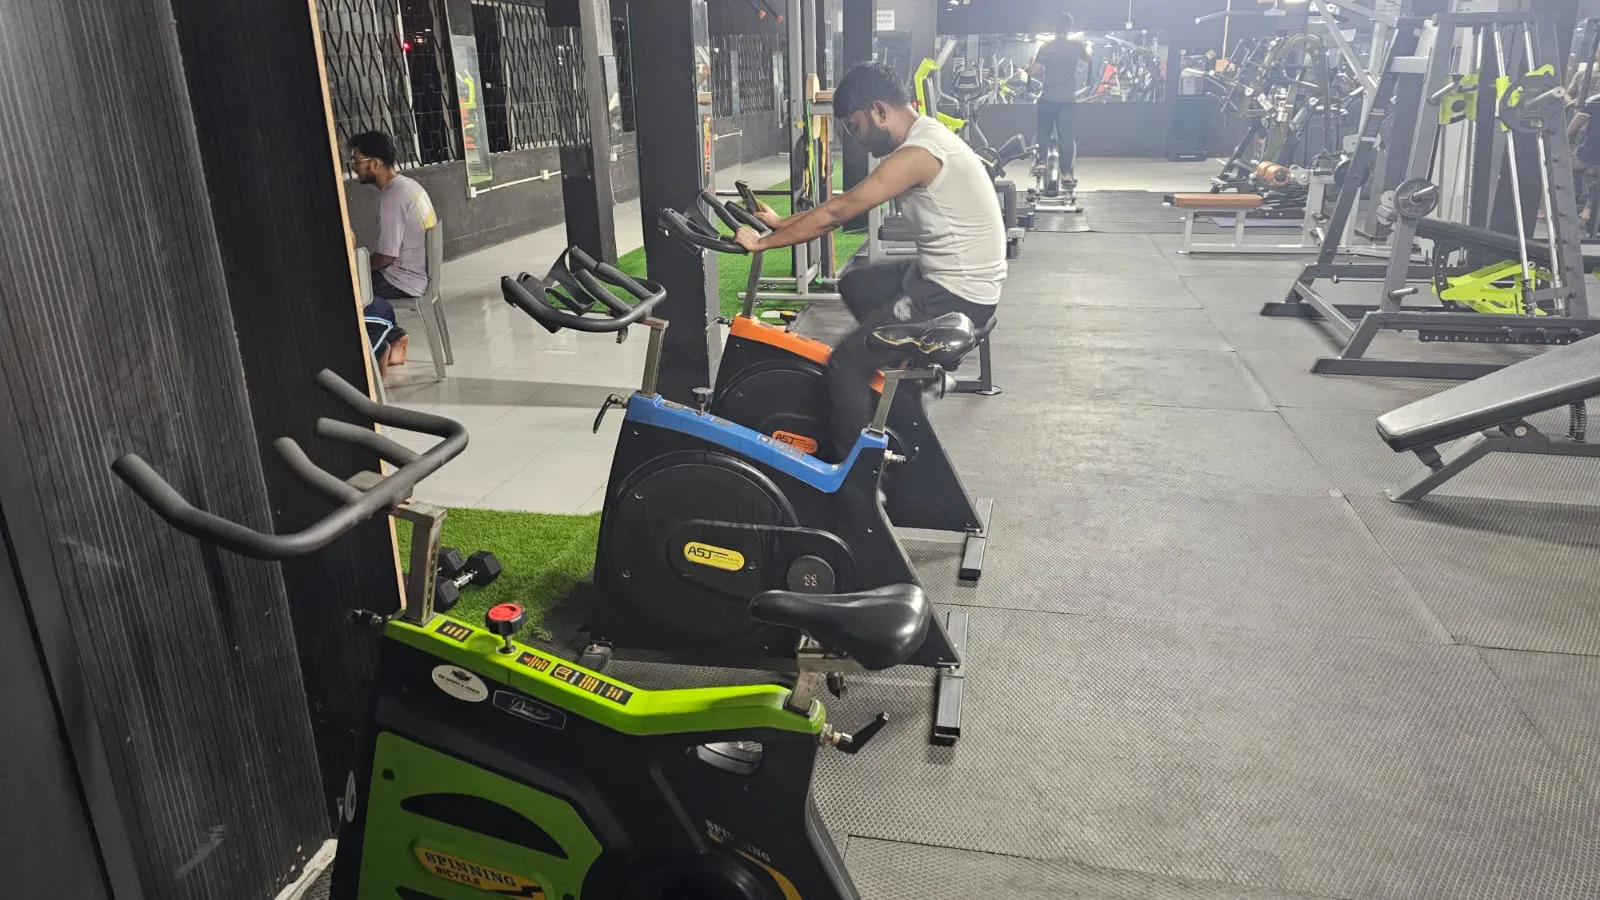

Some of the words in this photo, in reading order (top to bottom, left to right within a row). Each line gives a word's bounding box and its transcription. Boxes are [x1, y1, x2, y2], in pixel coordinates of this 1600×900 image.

[704, 818, 771, 862] SPINING
[425, 851, 517, 887] SPINNING
[435, 865, 481, 886] BICYCLE
